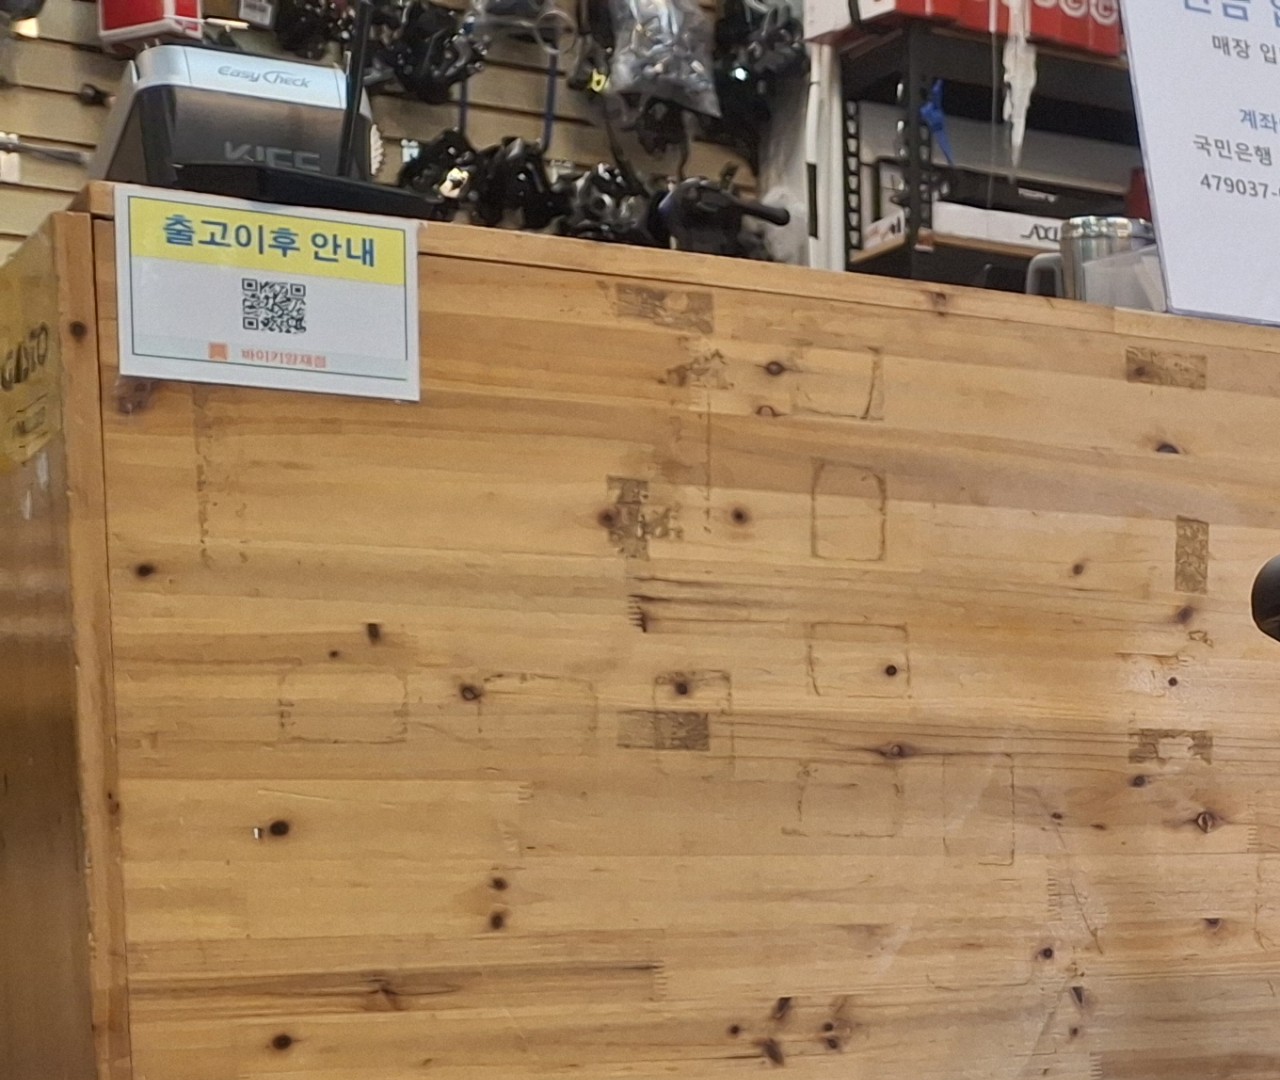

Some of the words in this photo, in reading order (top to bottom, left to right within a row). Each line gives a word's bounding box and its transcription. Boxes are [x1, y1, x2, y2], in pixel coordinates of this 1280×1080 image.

[1211, 34, 1251, 60] 매장
[1193, 134, 1273, 167] 국민은행
[163, 214, 301, 258] 출고이후
[310, 232, 375, 268] 안내
